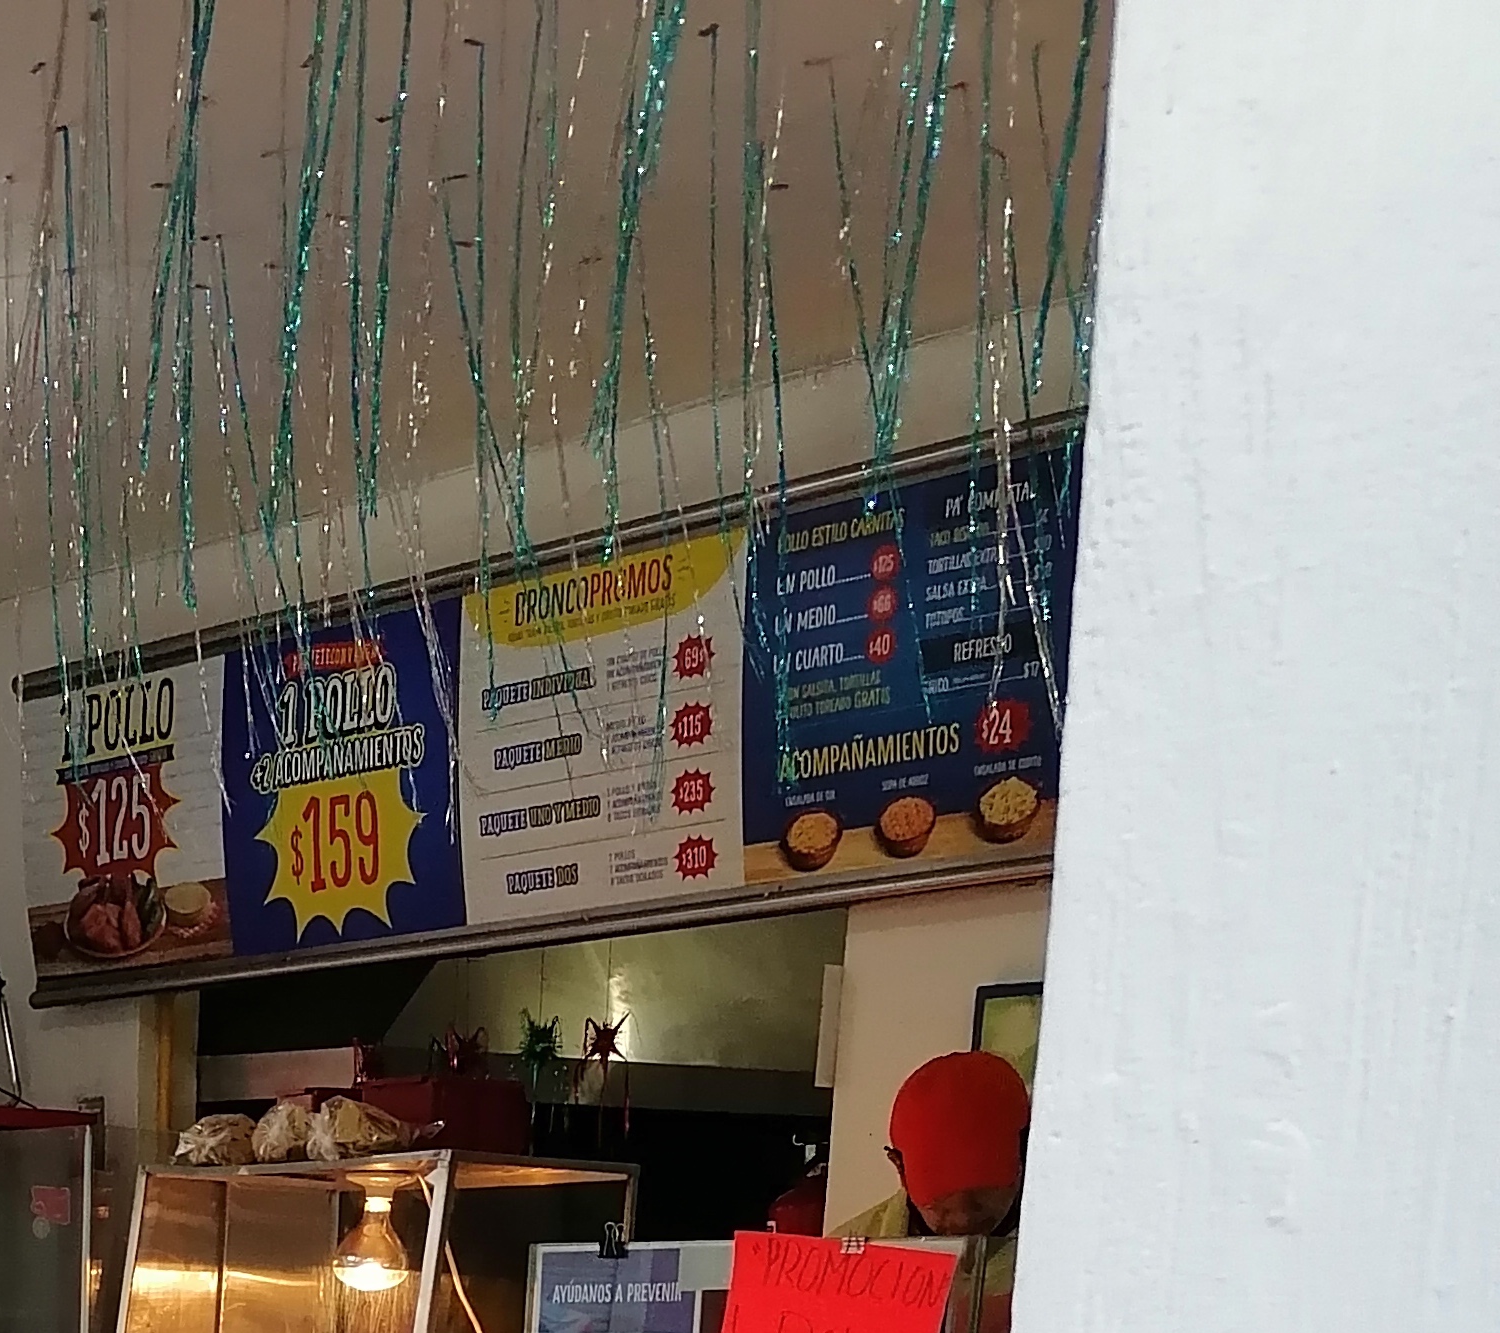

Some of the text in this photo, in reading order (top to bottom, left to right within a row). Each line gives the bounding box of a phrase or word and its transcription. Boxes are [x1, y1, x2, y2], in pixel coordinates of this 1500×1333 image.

[812, 522, 847, 547] ESTILO
[800, 565, 836, 592] POLLO
[797, 604, 836, 632] MEDIO
[796, 643, 844, 672] CUARTO
[869, 634, 891, 656] $40
[279, 663, 395, 744] 1 POLLO
[854, 685, 891, 709] GRATIS
[86, 677, 175, 757] POLLO
[982, 708, 1012, 745] $24
[494, 741, 542, 770] PAQUETE
[544, 733, 583, 761] MEDIO
[778, 722, 960, 783] ACOMPAÑAMIENTOS
[78, 773, 151, 867] $125
[480, 809, 527, 837] PAQUETE
[528, 806, 552, 828] UNO
[553, 803, 566, 825] Y
[565, 796, 601, 822] MEDIO
[290, 790, 380, 893] $159
[682, 845, 707, 870] $310
[507, 863, 578, 894] PAQUETE DOS
[553, 1278, 612, 1304] AYÚDANOS
[614, 1284, 623, 1303] A
